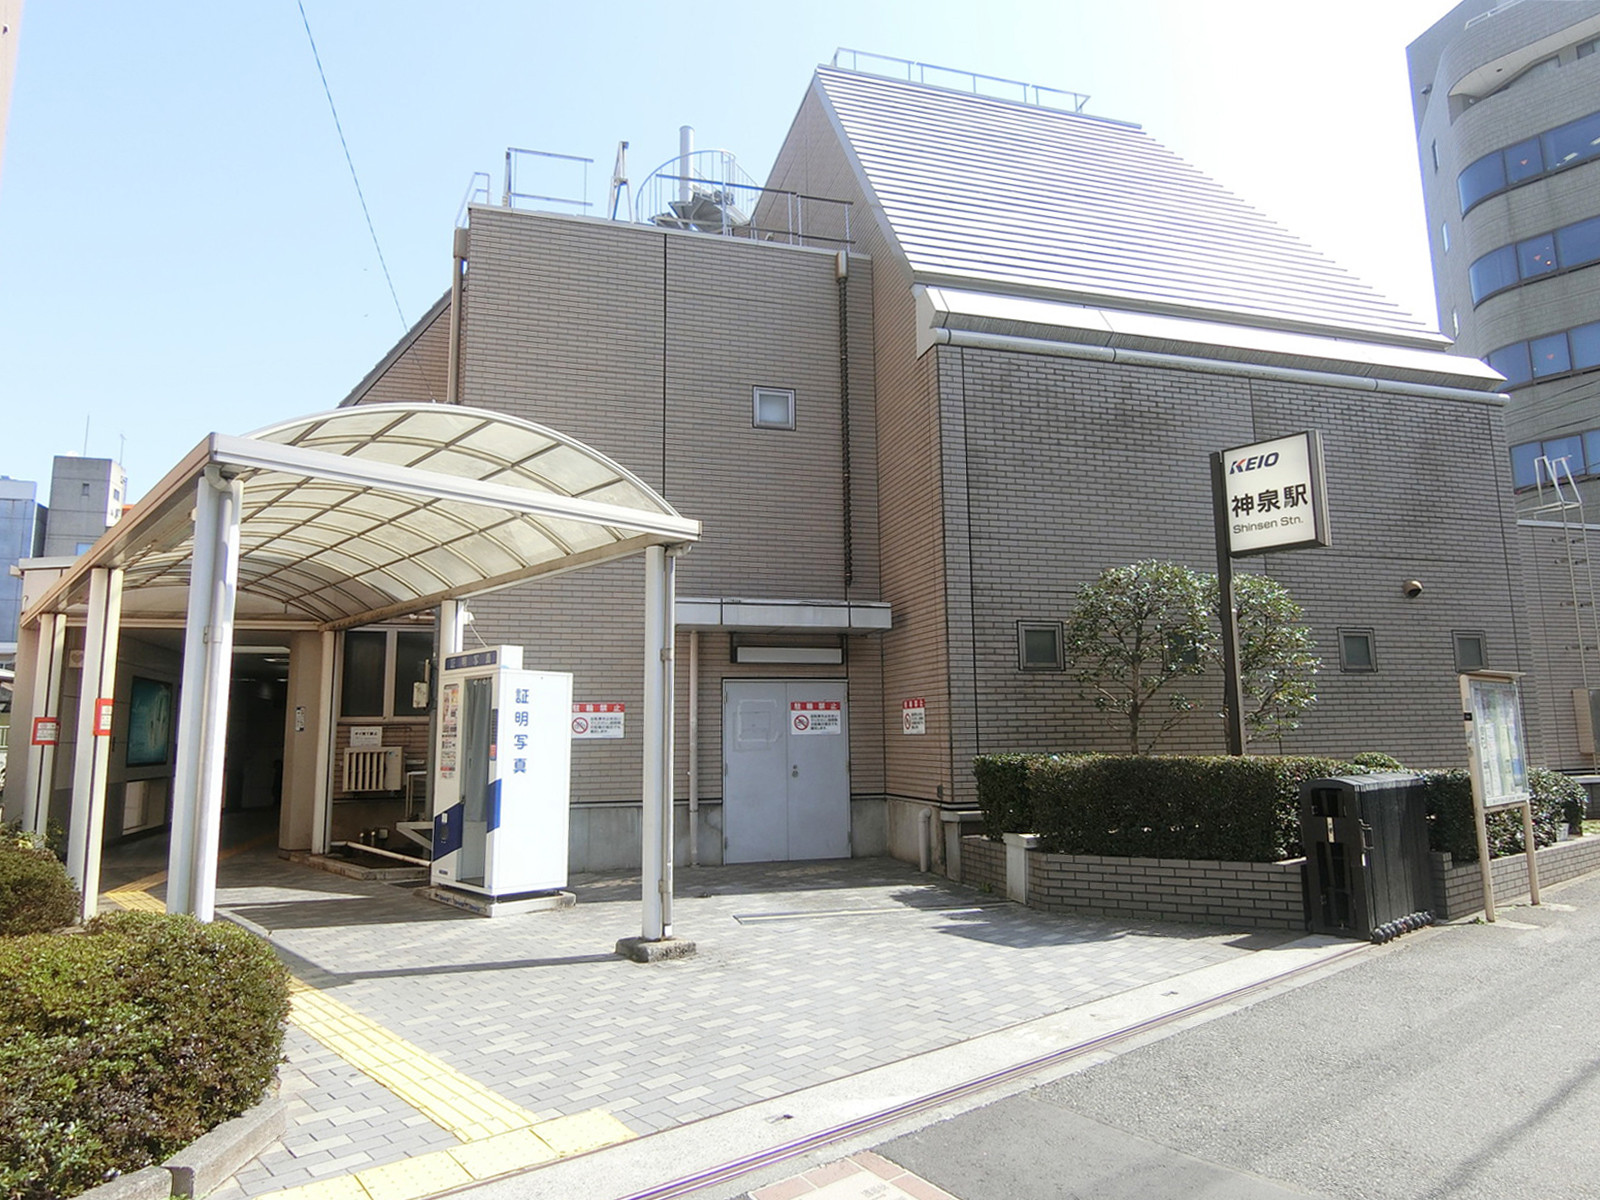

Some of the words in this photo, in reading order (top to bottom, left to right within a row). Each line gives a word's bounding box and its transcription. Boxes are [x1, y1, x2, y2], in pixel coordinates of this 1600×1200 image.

[1229, 452, 1280, 475] KEIO
[1231, 483, 1309, 518] 神泉駅
[1233, 520, 1278, 535] Shinsen
[1280, 516, 1304, 527] Stn.
[513, 688, 530, 774] 証明写真
